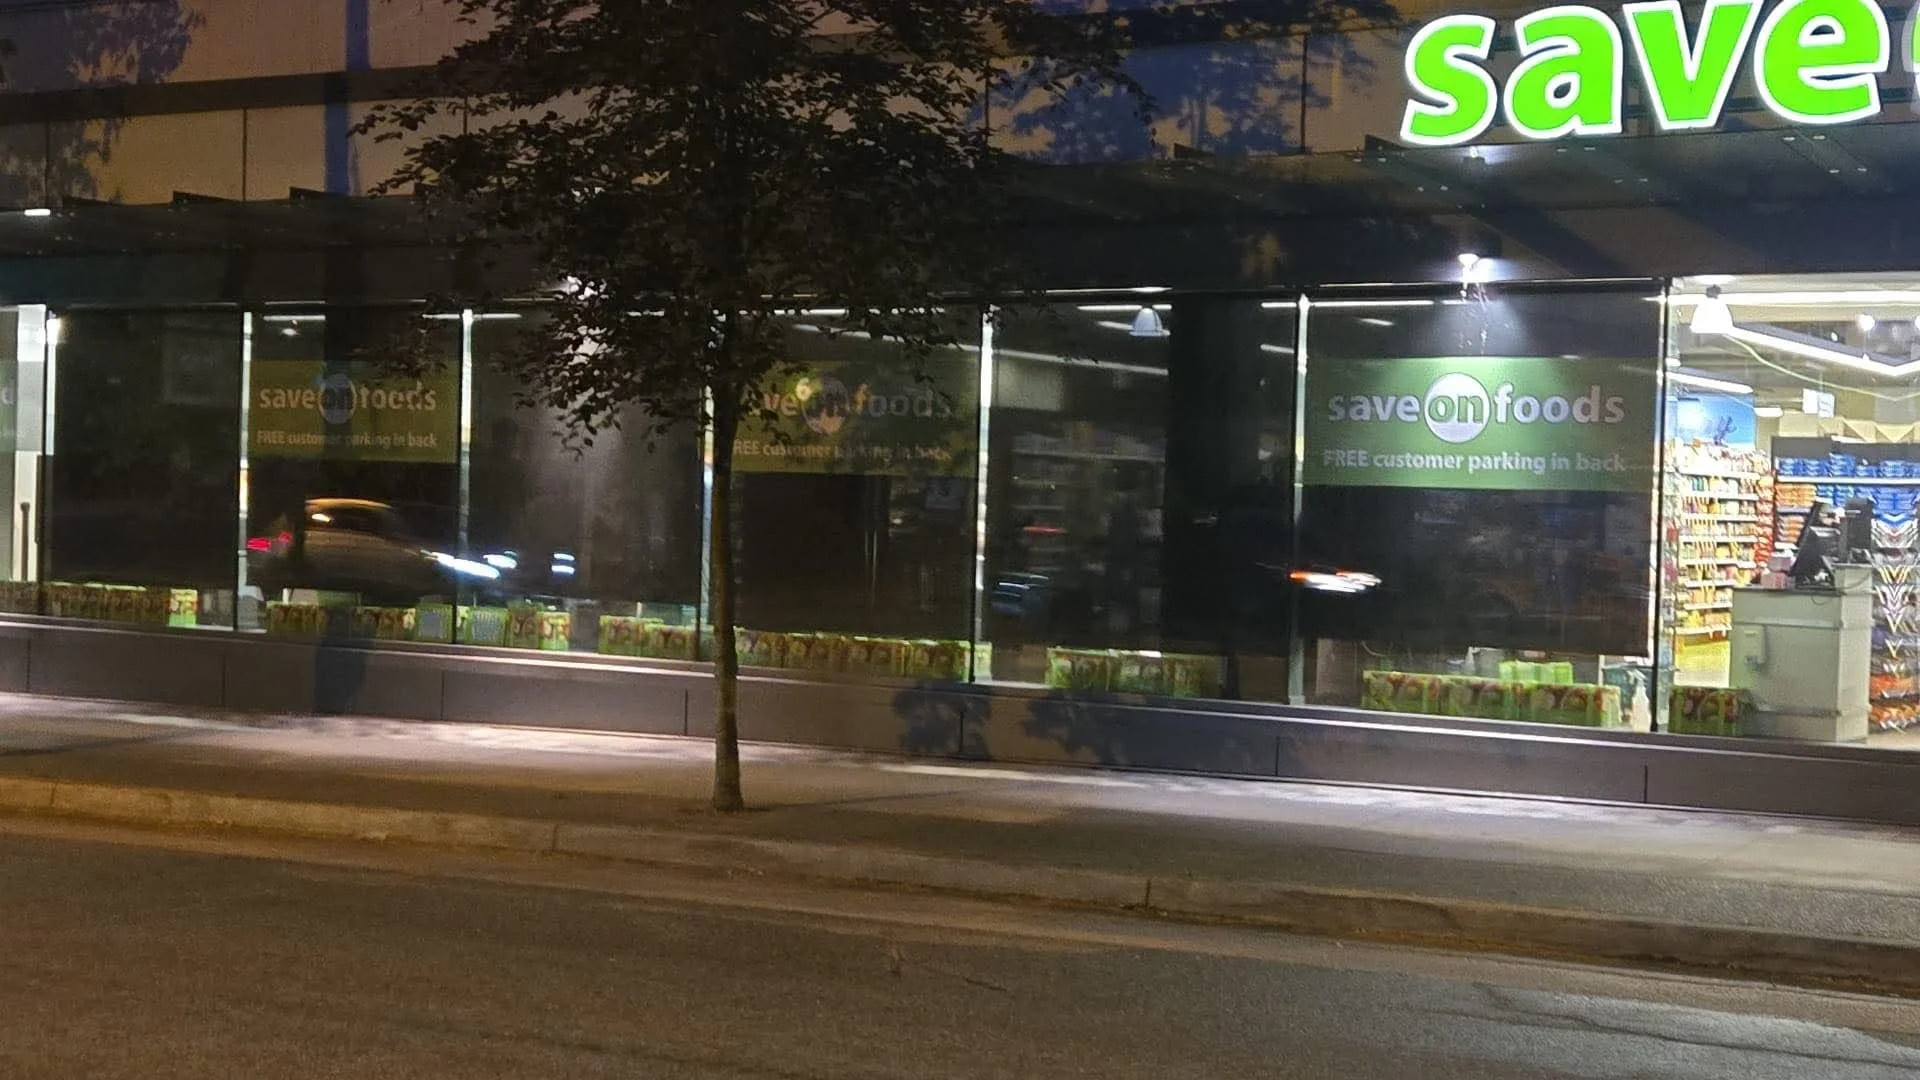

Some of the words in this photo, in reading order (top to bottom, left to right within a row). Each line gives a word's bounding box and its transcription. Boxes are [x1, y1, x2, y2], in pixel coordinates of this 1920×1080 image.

[1400, 0, 1889, 146] save
[259, 387, 315, 409] save
[1328, 394, 1420, 422] save
[1428, 394, 1484, 423] on
[1492, 381, 1625, 424] foods
[256, 431, 285, 446] FREE
[407, 432, 438, 448] back
[733, 440, 760, 457] REE
[1323, 449, 1368, 468] FREE
[1373, 451, 1464, 470] customer
[1467, 451, 1546, 475] parking
[1551, 453, 1570, 470] in
[1576, 452, 1625, 472] back
